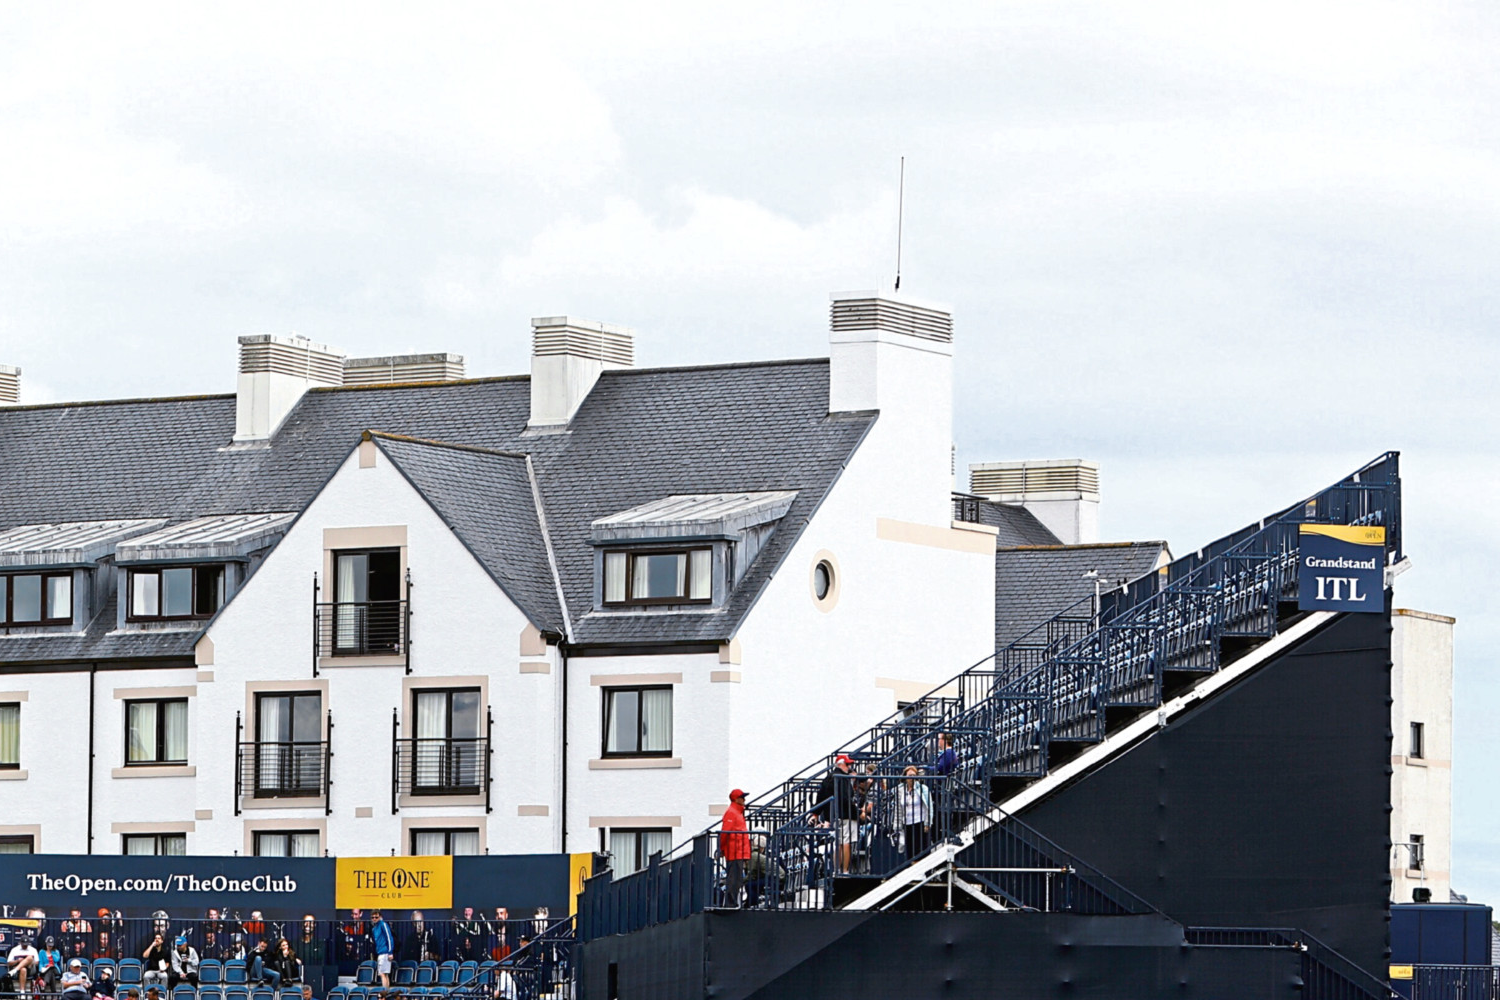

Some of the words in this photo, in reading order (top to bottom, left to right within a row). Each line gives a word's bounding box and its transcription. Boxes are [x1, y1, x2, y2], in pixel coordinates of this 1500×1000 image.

[1305, 556, 1376, 570] Grandstand
[26, 873, 297, 895] TheOpen.com/TheOneClub
[353, 870, 387, 888] THE
